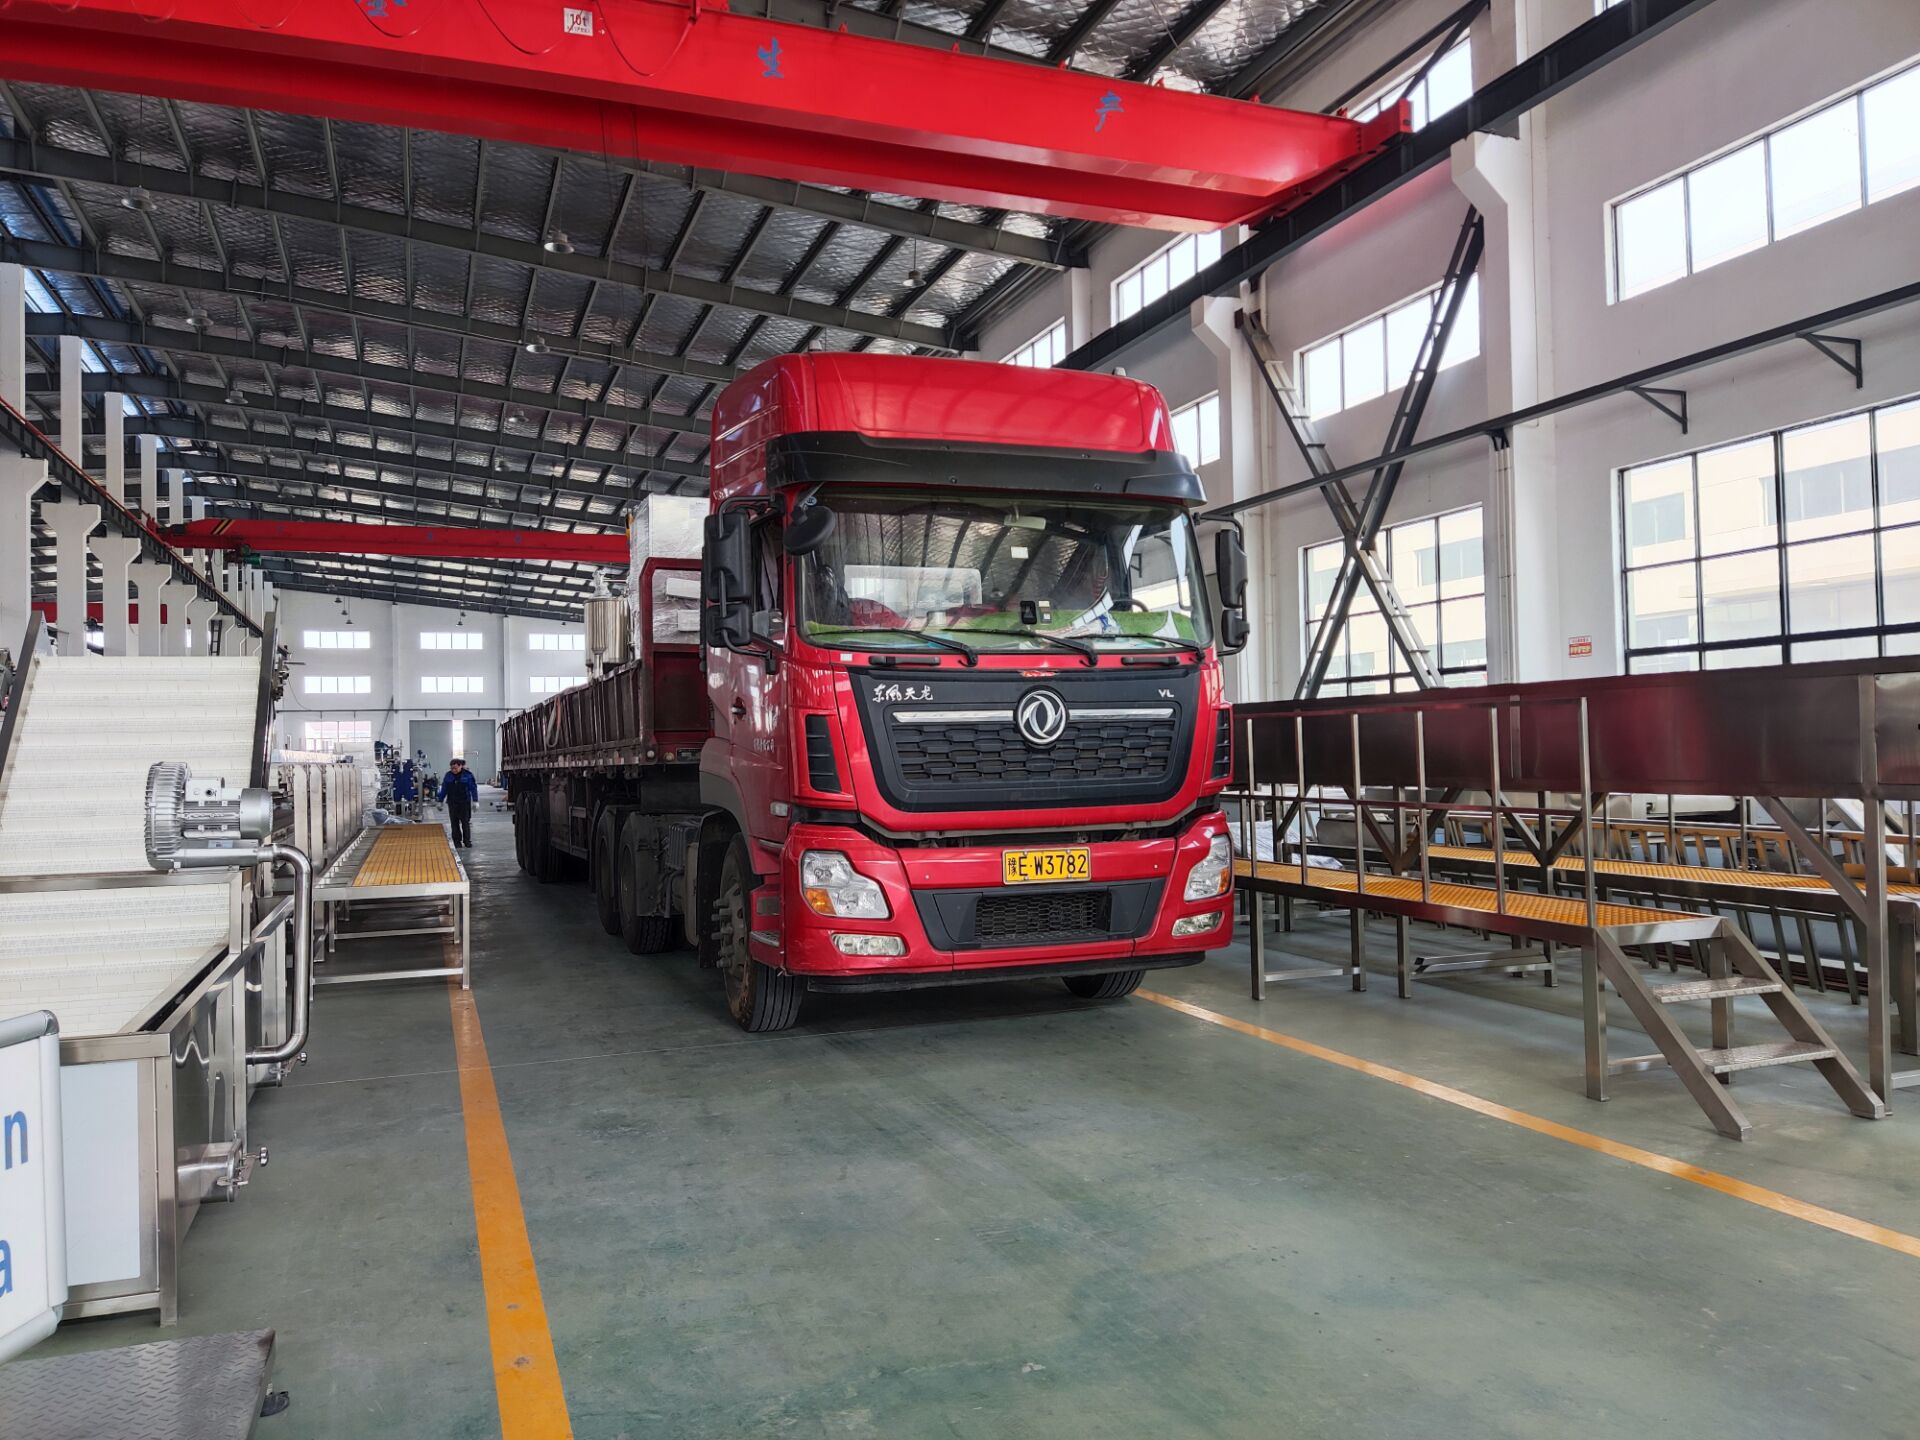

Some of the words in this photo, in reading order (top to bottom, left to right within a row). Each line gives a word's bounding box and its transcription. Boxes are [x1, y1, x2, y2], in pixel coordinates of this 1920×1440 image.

[757, 37, 784, 79] 生
[1094, 90, 1124, 132] 产
[872, 683, 934, 703] 东风天龙
[1158, 688, 1175, 698] VL
[4, 1110, 29, 1170] n
